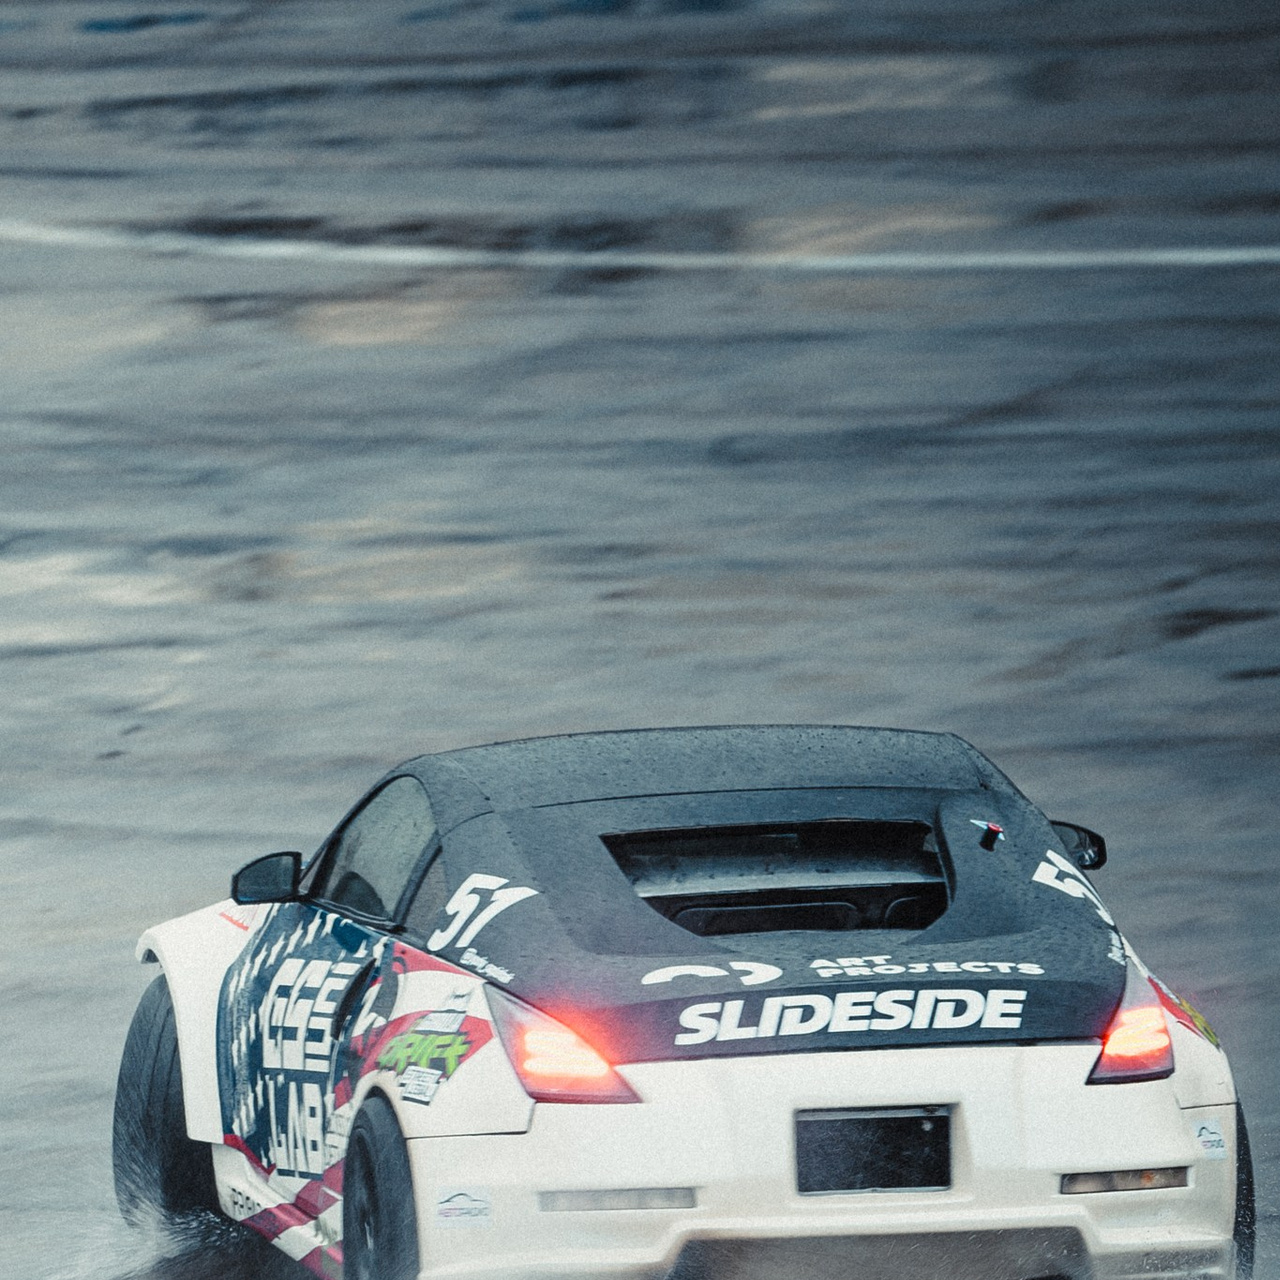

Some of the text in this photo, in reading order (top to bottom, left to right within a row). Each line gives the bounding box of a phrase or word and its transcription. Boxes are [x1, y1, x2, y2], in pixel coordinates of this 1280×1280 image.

[810, 955, 892, 968] ART
[816, 962, 1045, 978] PROJECTS
[674, 989, 1028, 1045] SLIDESIDE
